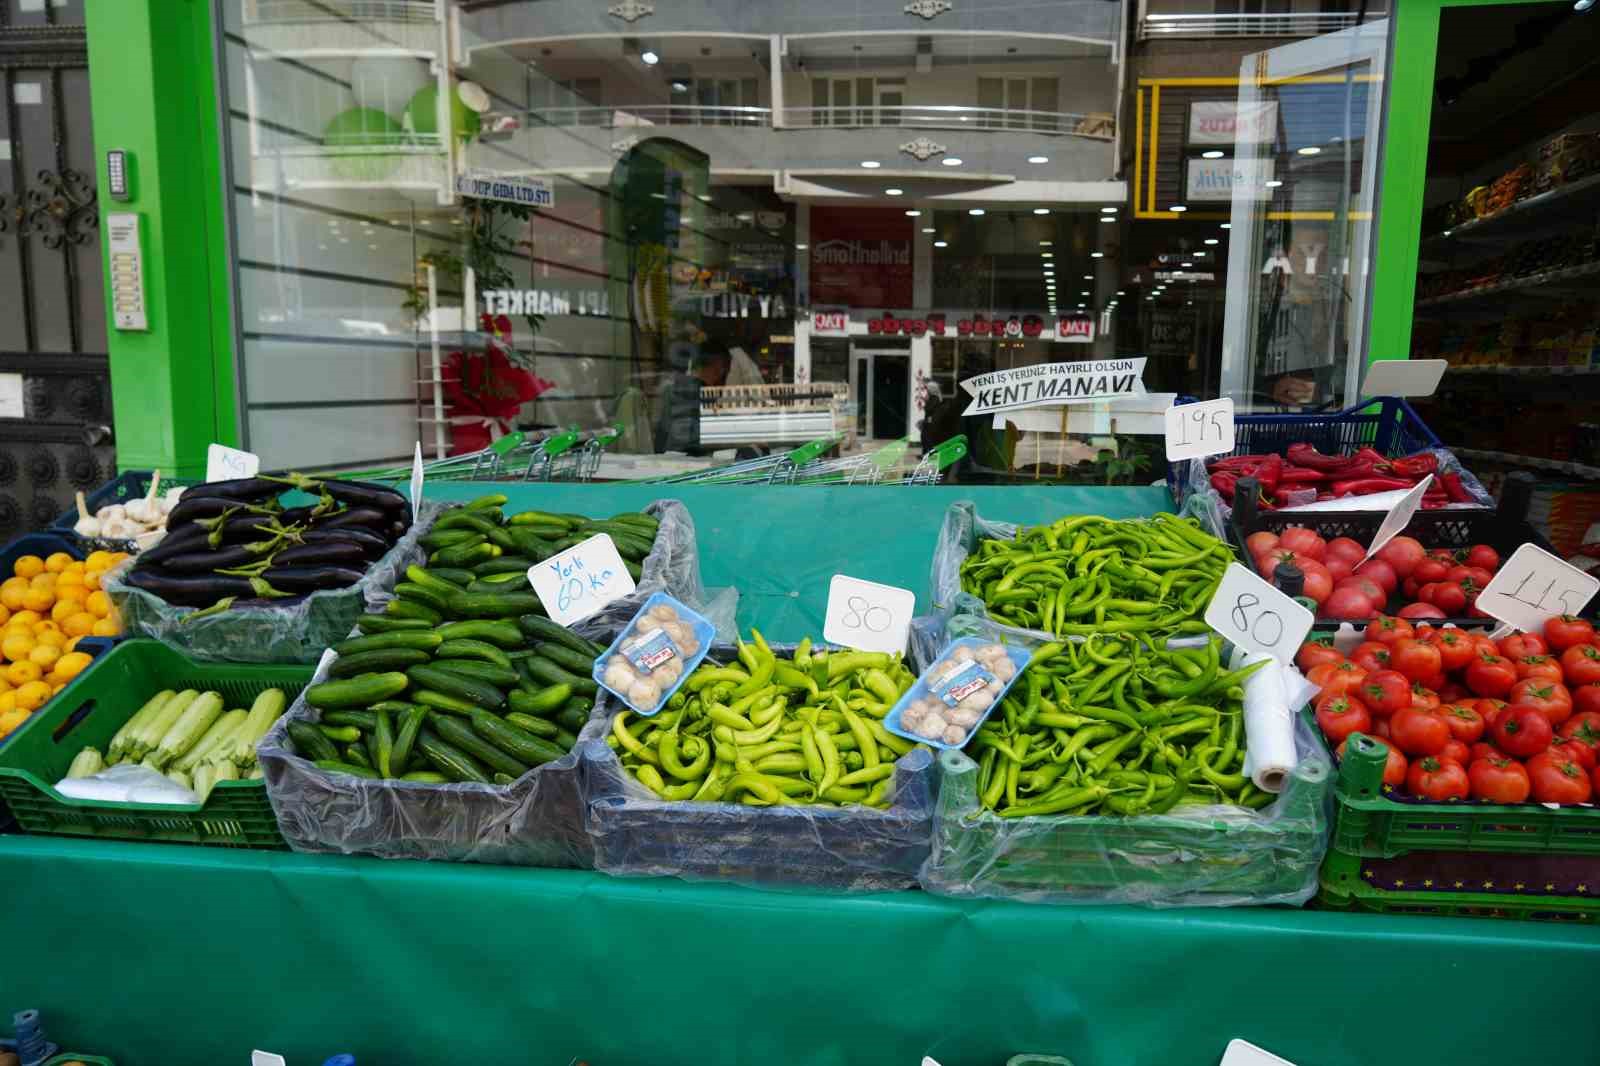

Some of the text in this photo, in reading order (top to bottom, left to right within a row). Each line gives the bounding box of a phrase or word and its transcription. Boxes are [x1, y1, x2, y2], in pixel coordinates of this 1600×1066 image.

[1095, 361, 1133, 372] OLSUN
[977, 374, 1136, 408] KENT MANAVI
[1175, 409, 1228, 447] 195
[558, 578, 583, 612] 60
[1498, 570, 1585, 616] 115
[841, 596, 893, 633] 80
[1231, 592, 1284, 647] 80
